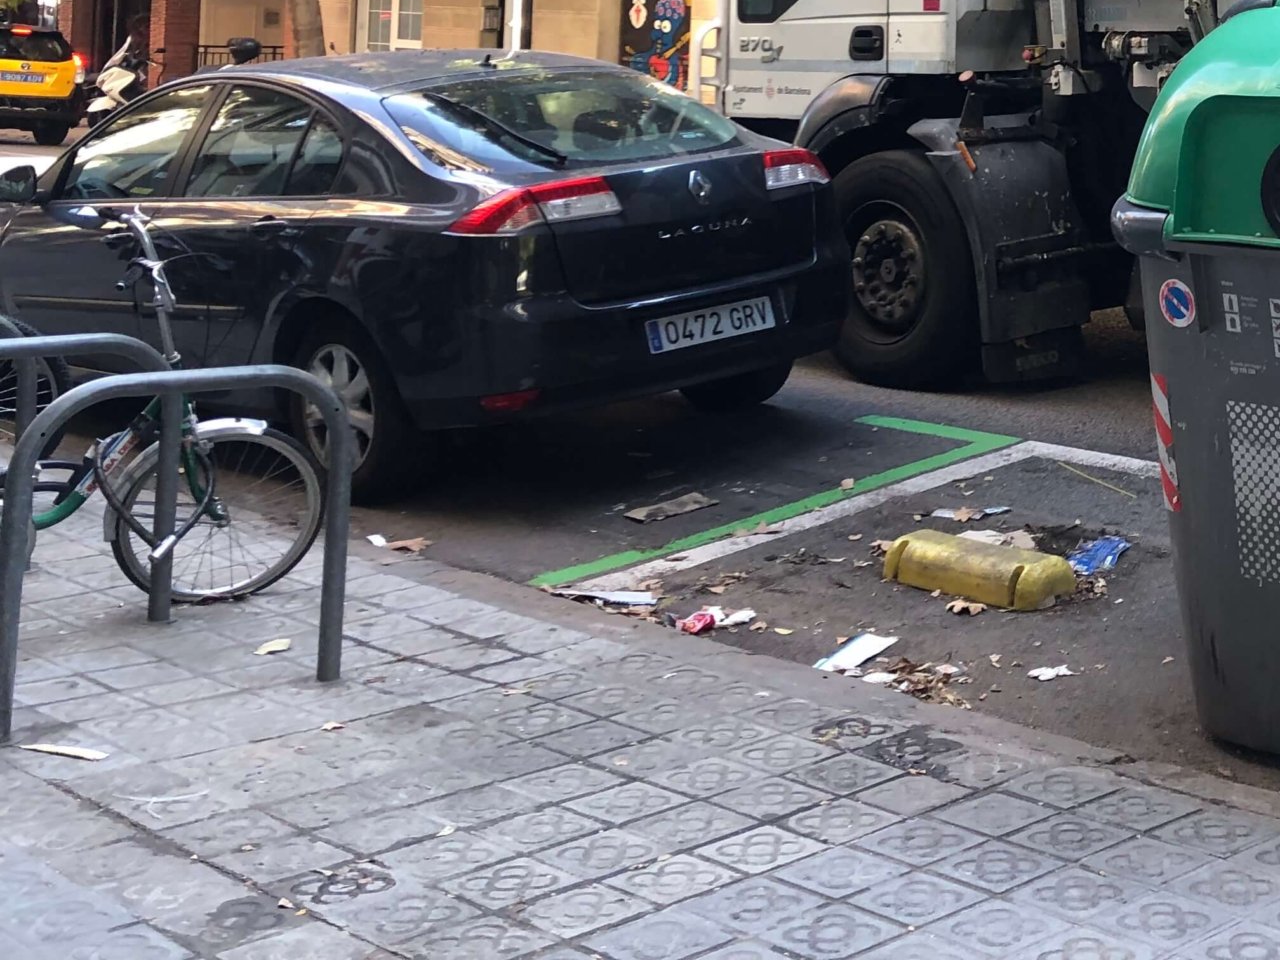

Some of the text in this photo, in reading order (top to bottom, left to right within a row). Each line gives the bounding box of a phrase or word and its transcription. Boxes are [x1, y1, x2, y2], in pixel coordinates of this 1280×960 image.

[738, 36, 773, 53] 270
[657, 216, 753, 239] LAGUNA
[664, 300, 768, 345] 0472 GRV
